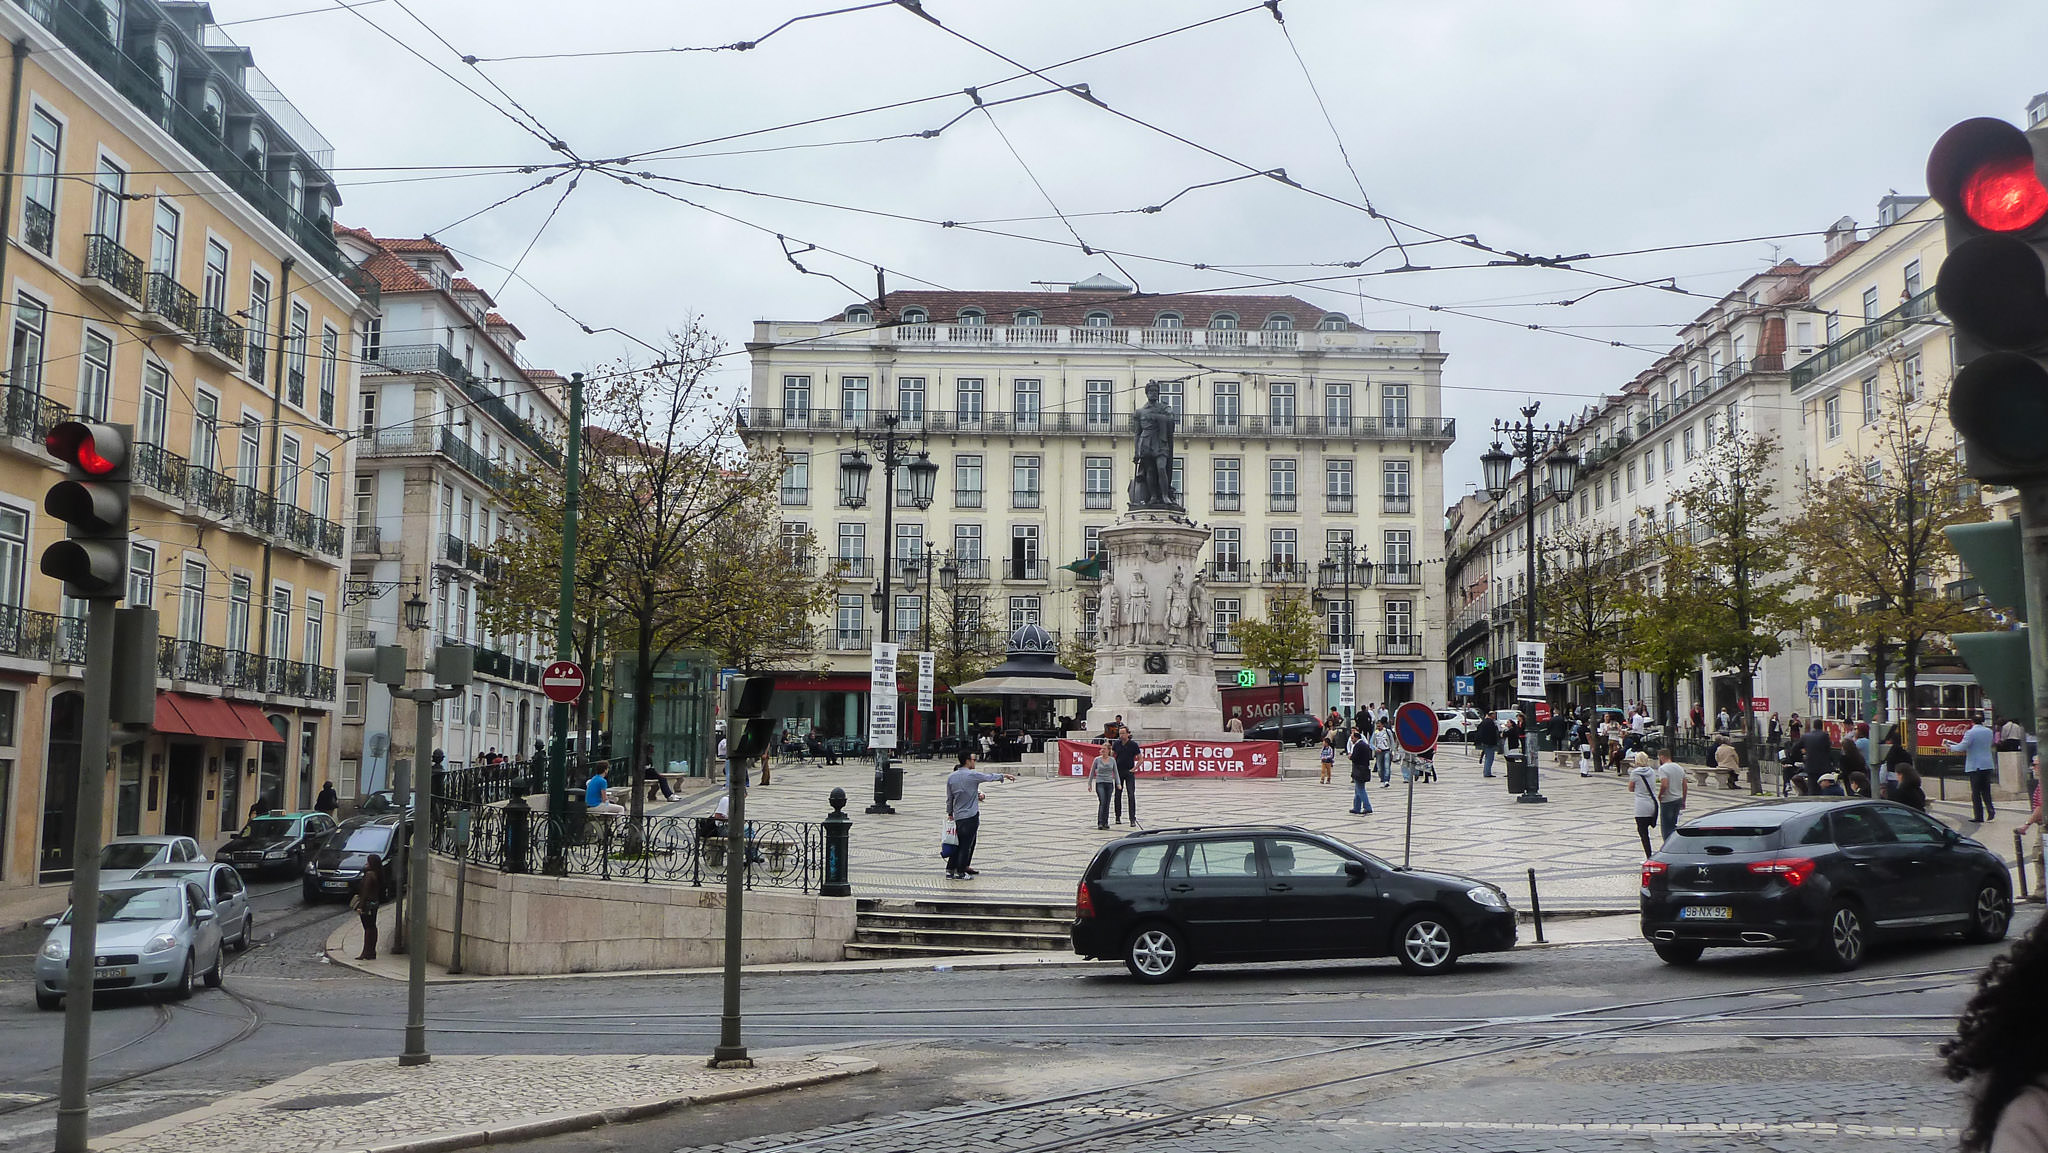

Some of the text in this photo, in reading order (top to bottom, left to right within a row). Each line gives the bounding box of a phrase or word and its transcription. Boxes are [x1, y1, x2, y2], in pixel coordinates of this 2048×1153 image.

[1457, 681, 1466, 692] P
[1247, 702, 1295, 718] SAGRES
[1183, 744, 1192, 758] É
[1194, 746, 1234, 758] FOGO
[1164, 760, 1194, 772] SEM
[1198, 760, 1216, 772] SE
[1216, 760, 1244, 772] VER
